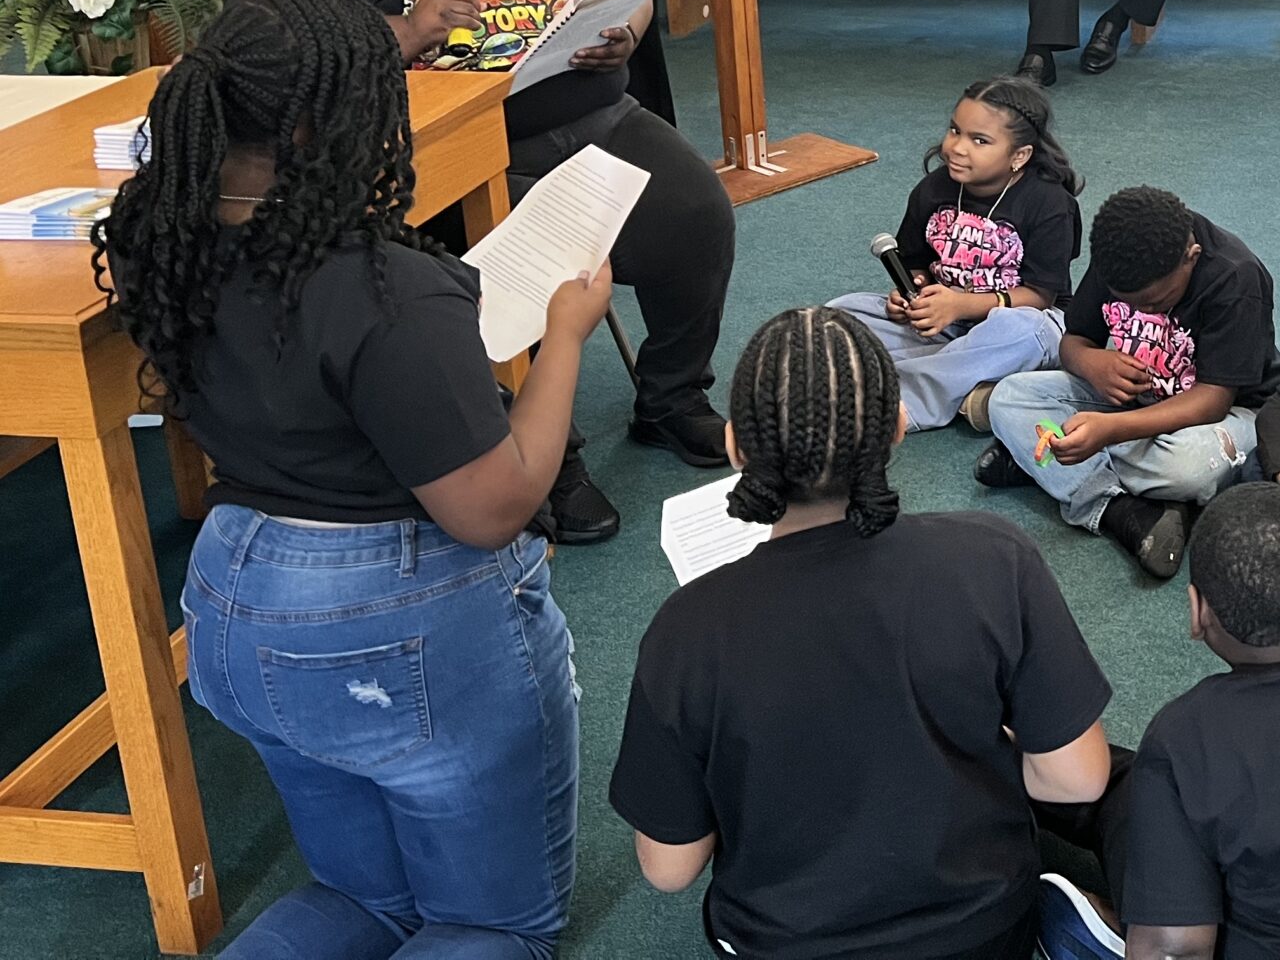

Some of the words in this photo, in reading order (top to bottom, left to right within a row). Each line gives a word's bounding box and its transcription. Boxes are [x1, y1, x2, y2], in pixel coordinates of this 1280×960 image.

[952, 223, 960, 239] I
[960, 225, 984, 246] AM
[941, 265, 997, 286] STORY
